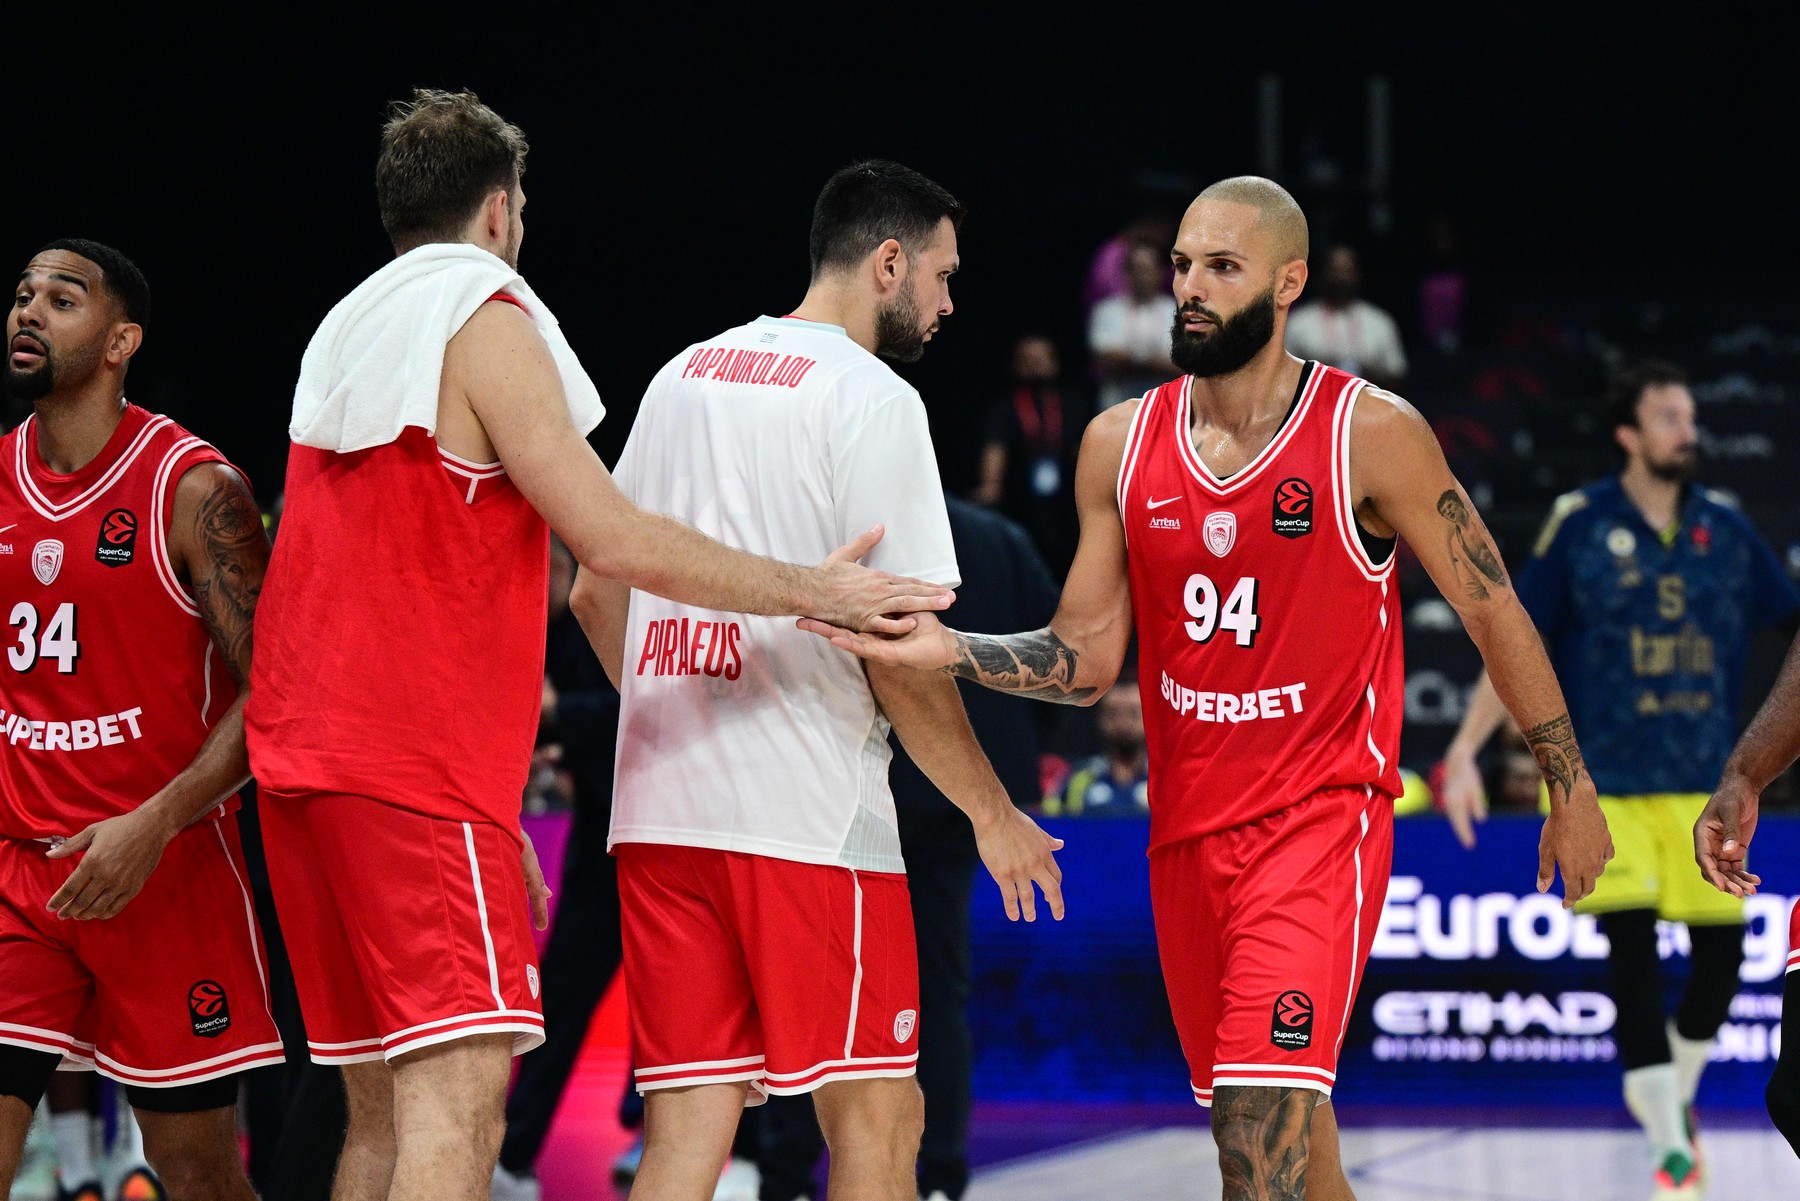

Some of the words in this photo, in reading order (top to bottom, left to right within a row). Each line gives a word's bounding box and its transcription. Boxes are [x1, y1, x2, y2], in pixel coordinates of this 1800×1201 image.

[682, 348, 816, 388] PAPANIKOLAOU
[1275, 519, 1310, 527] SuperCup
[98, 547, 131, 558] SuperCup
[1183, 573, 1260, 648] 94
[7, 601, 80, 674] 34
[637, 617, 742, 681] PIRAEUS
[1161, 670, 1306, 723] SUPERBET
[195, 1016, 228, 1030] SuperCup
[1372, 991, 1618, 1035] ETIHAD
[1273, 1030, 1309, 1041] SuperCup
